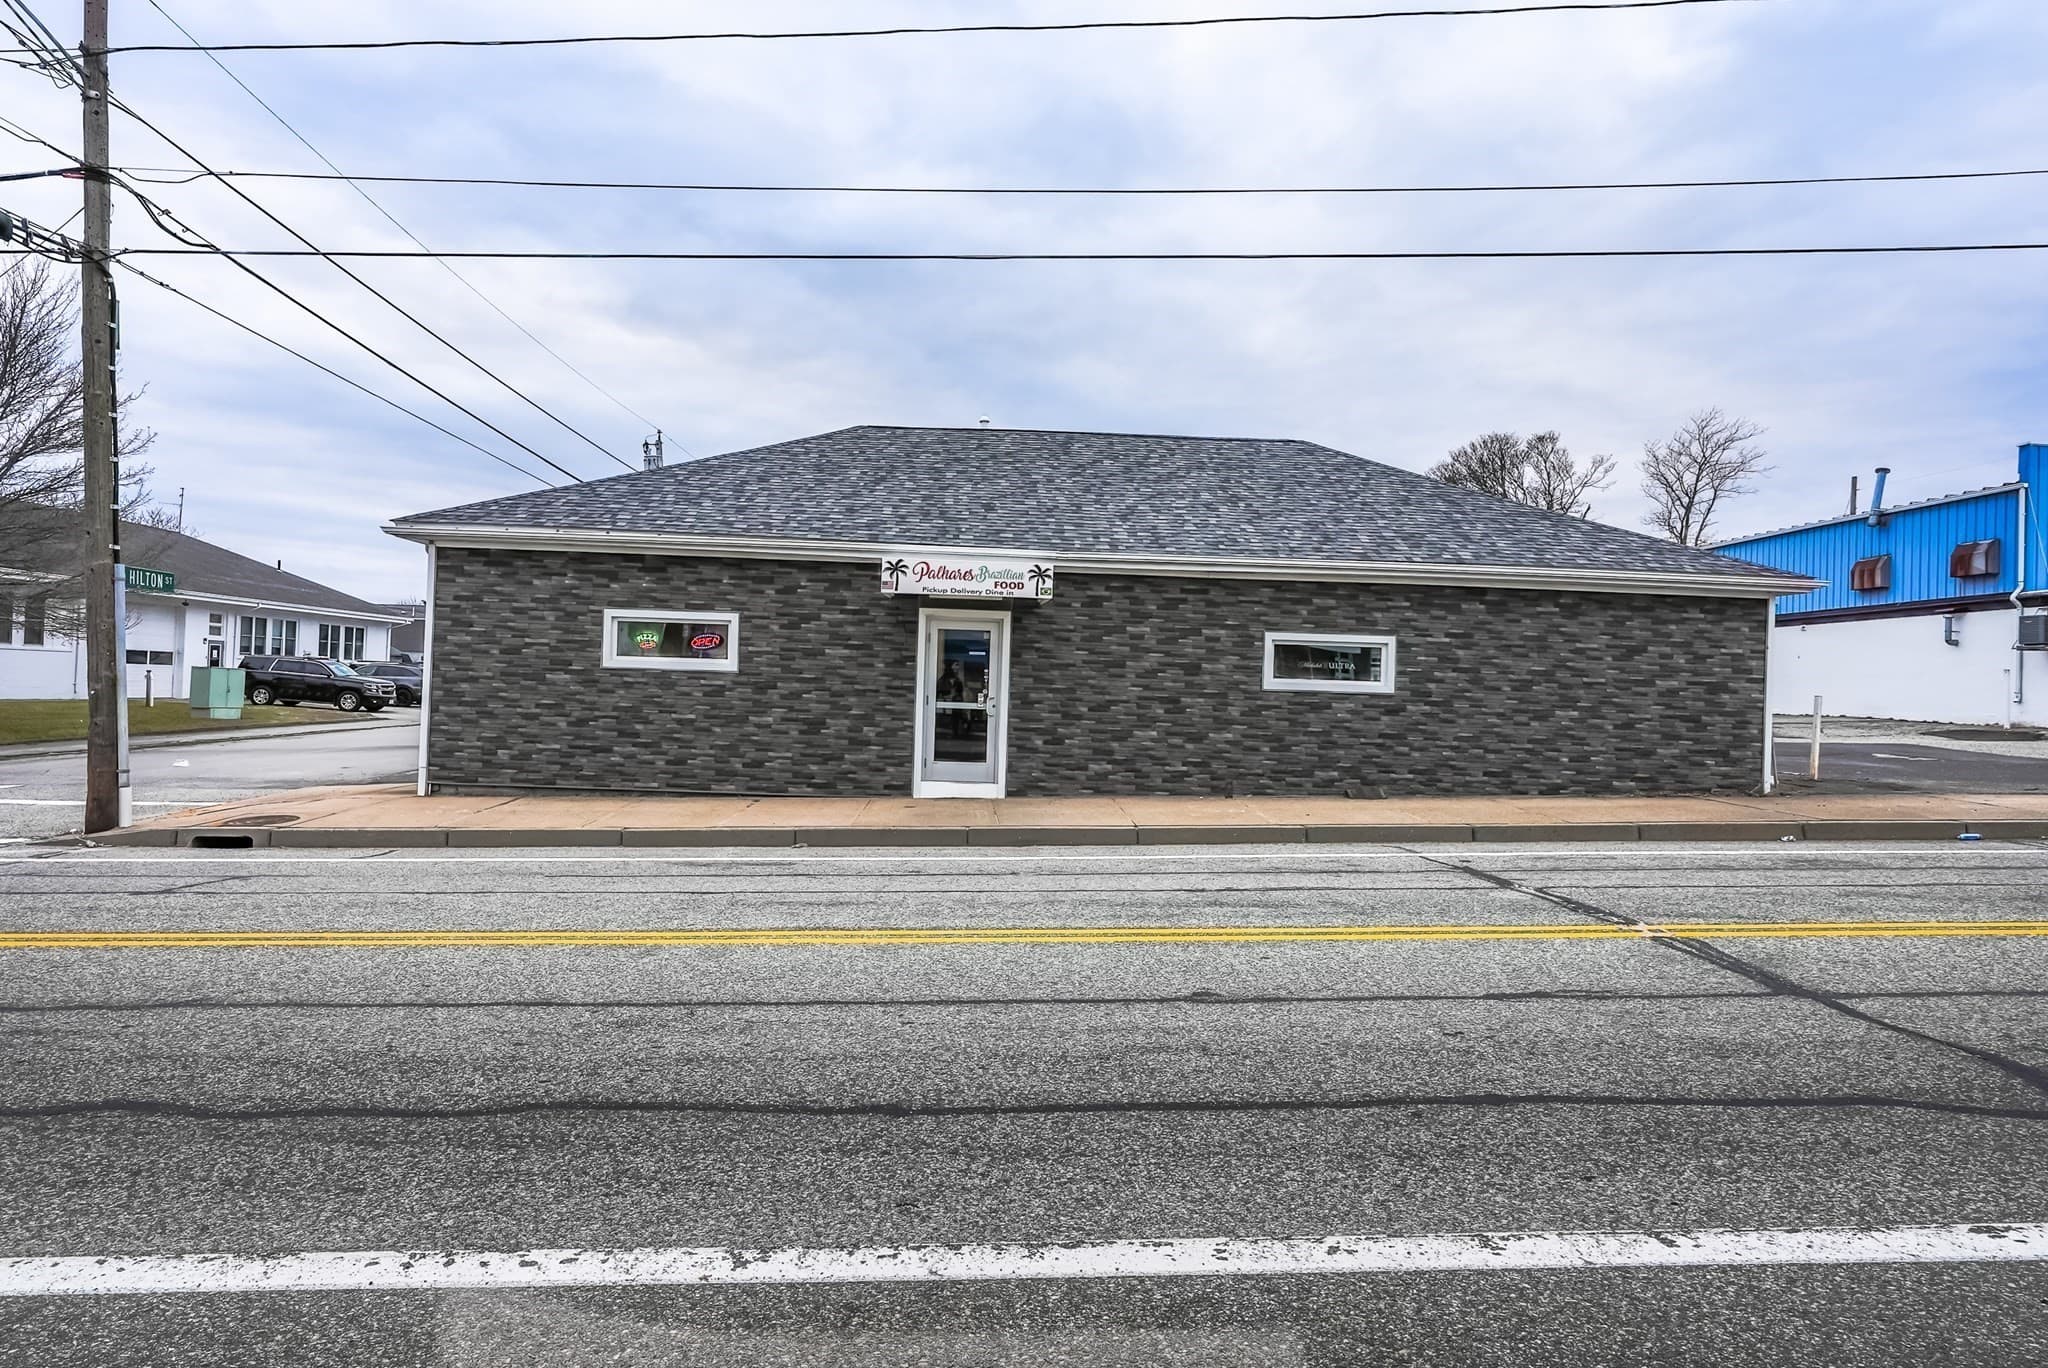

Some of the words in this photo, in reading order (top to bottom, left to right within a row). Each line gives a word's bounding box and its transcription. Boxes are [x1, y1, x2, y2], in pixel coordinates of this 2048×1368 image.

[912, 561, 975, 582] Palhares
[129, 570, 163, 588] HILTON
[165, 577, 173, 585] ST
[922, 586, 948, 594] Pickup
[994, 581, 1024, 590] FOOD
[692, 636, 720, 647] OPEN
[1328, 661, 1356, 670] ULTRA
